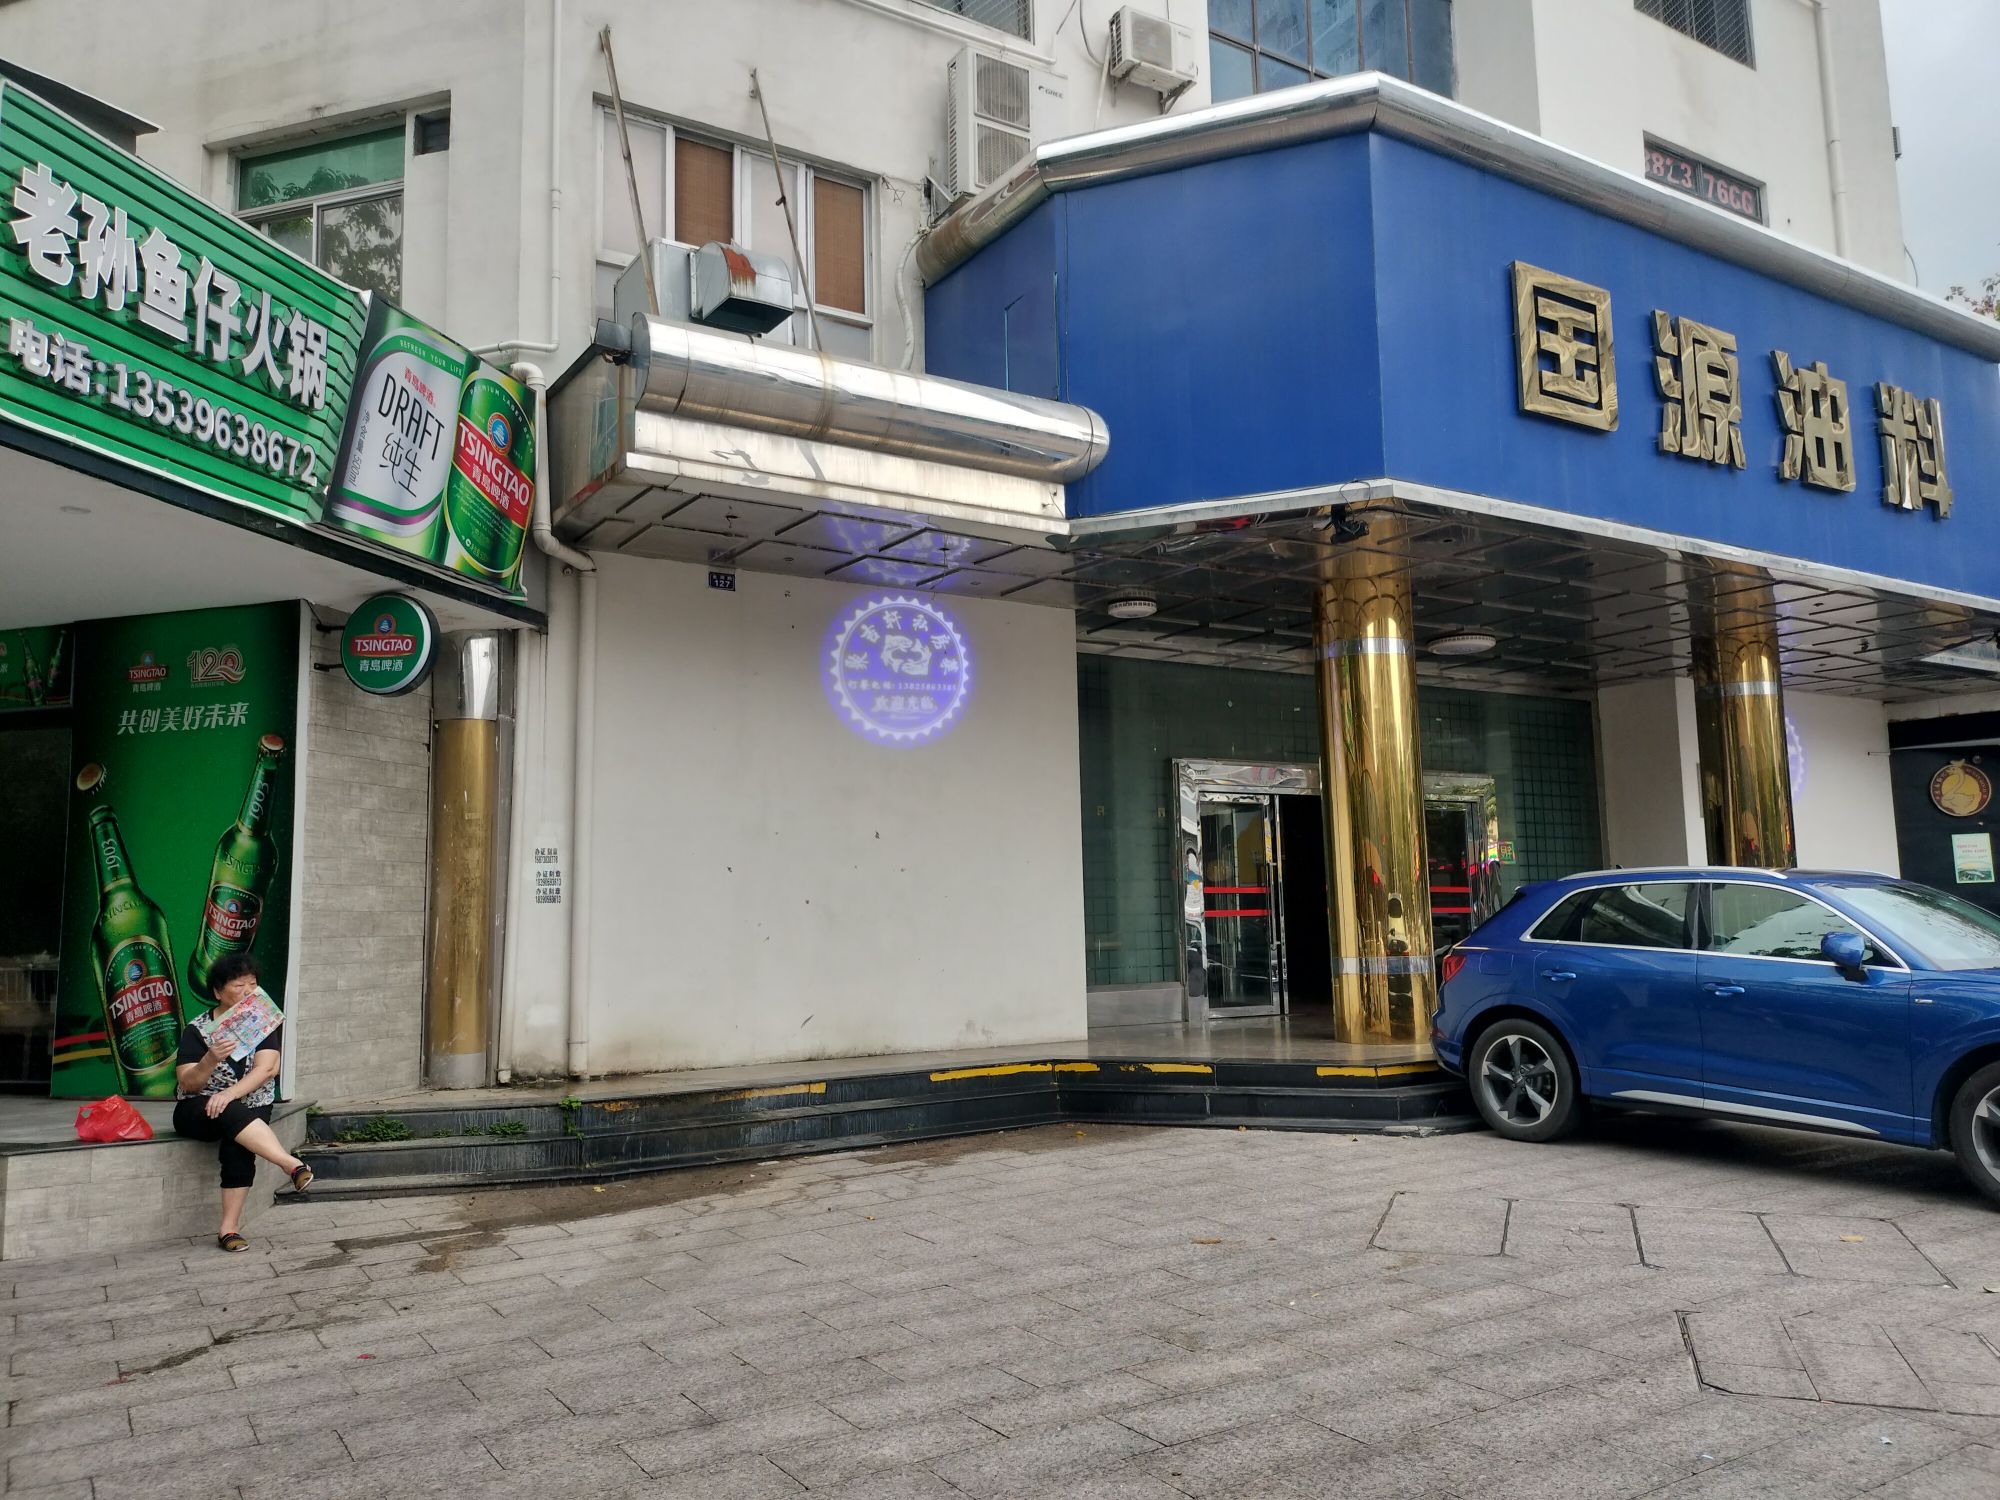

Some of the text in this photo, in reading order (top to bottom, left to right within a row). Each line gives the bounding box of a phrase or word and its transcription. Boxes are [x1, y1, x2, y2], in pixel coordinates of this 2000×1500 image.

[9, 161, 328, 411] 老孙鱼仔火锅
[431, 353, 447, 368] YOUR
[450, 363, 463, 377] LIFE
[1511, 260, 1952, 520] 国源油料
[378, 373, 445, 461] DRAFT
[379, 432, 422, 498] 纯生
[459, 421, 530, 506] TSINGTAO
[714, 579, 731, 588] 127
[354, 638, 413, 652] TSINGTAO
[129, 667, 167, 680] TSINGTAO
[117, 702, 250, 735] 共创美好未来
[250, 781, 270, 821] 1903
[101, 838, 122, 871] 1903
[208, 901, 257, 930] TSINGTAO
[109, 980, 174, 1020] TSINGTAO
